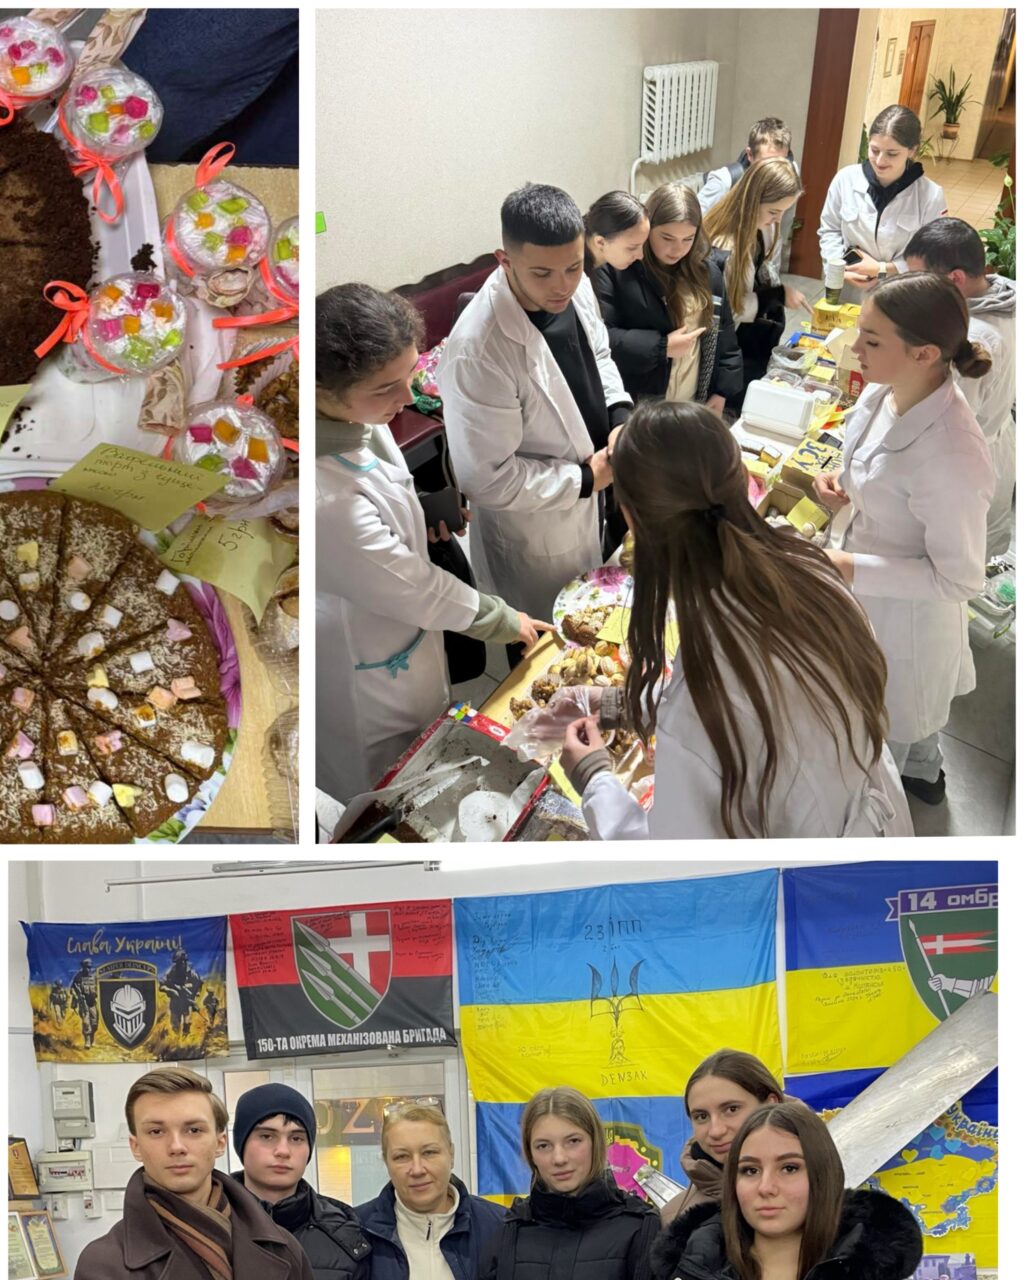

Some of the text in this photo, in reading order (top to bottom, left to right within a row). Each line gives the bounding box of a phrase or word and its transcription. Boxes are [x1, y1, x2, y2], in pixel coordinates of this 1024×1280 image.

[907, 891, 937, 911] 14
[66, 927, 182, 956] Слава Україні!
[257, 1027, 447, 1052] 150-ТА ОКРЕМА МЕХАНІЗОВАНА БРИГАДА
